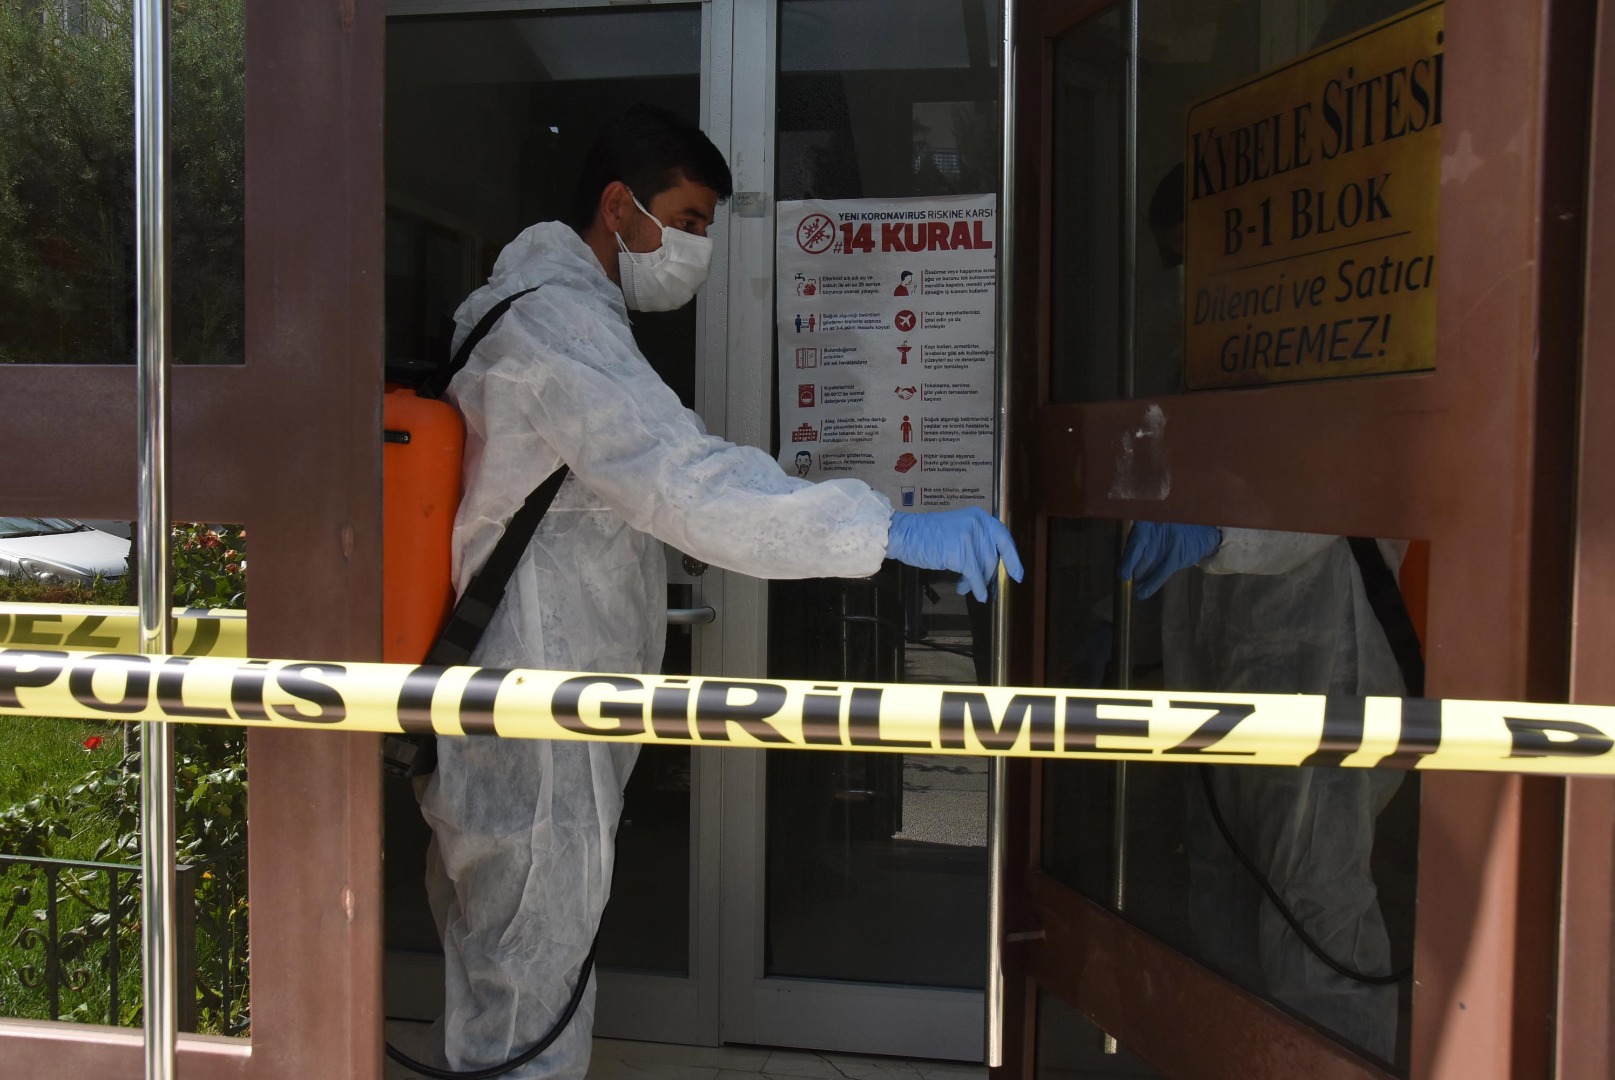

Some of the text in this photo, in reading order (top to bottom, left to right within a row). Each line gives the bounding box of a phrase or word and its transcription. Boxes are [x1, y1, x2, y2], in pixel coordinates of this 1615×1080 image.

[1192, 103, 1312, 201] KYBELE
[881, 220, 993, 253] KURAL
[1223, 173, 1392, 256] B-1 BLOK
[1193, 254, 1435, 326] Dilenci ve Satıcı
[1220, 313, 1392, 374] GİREMEZ!
